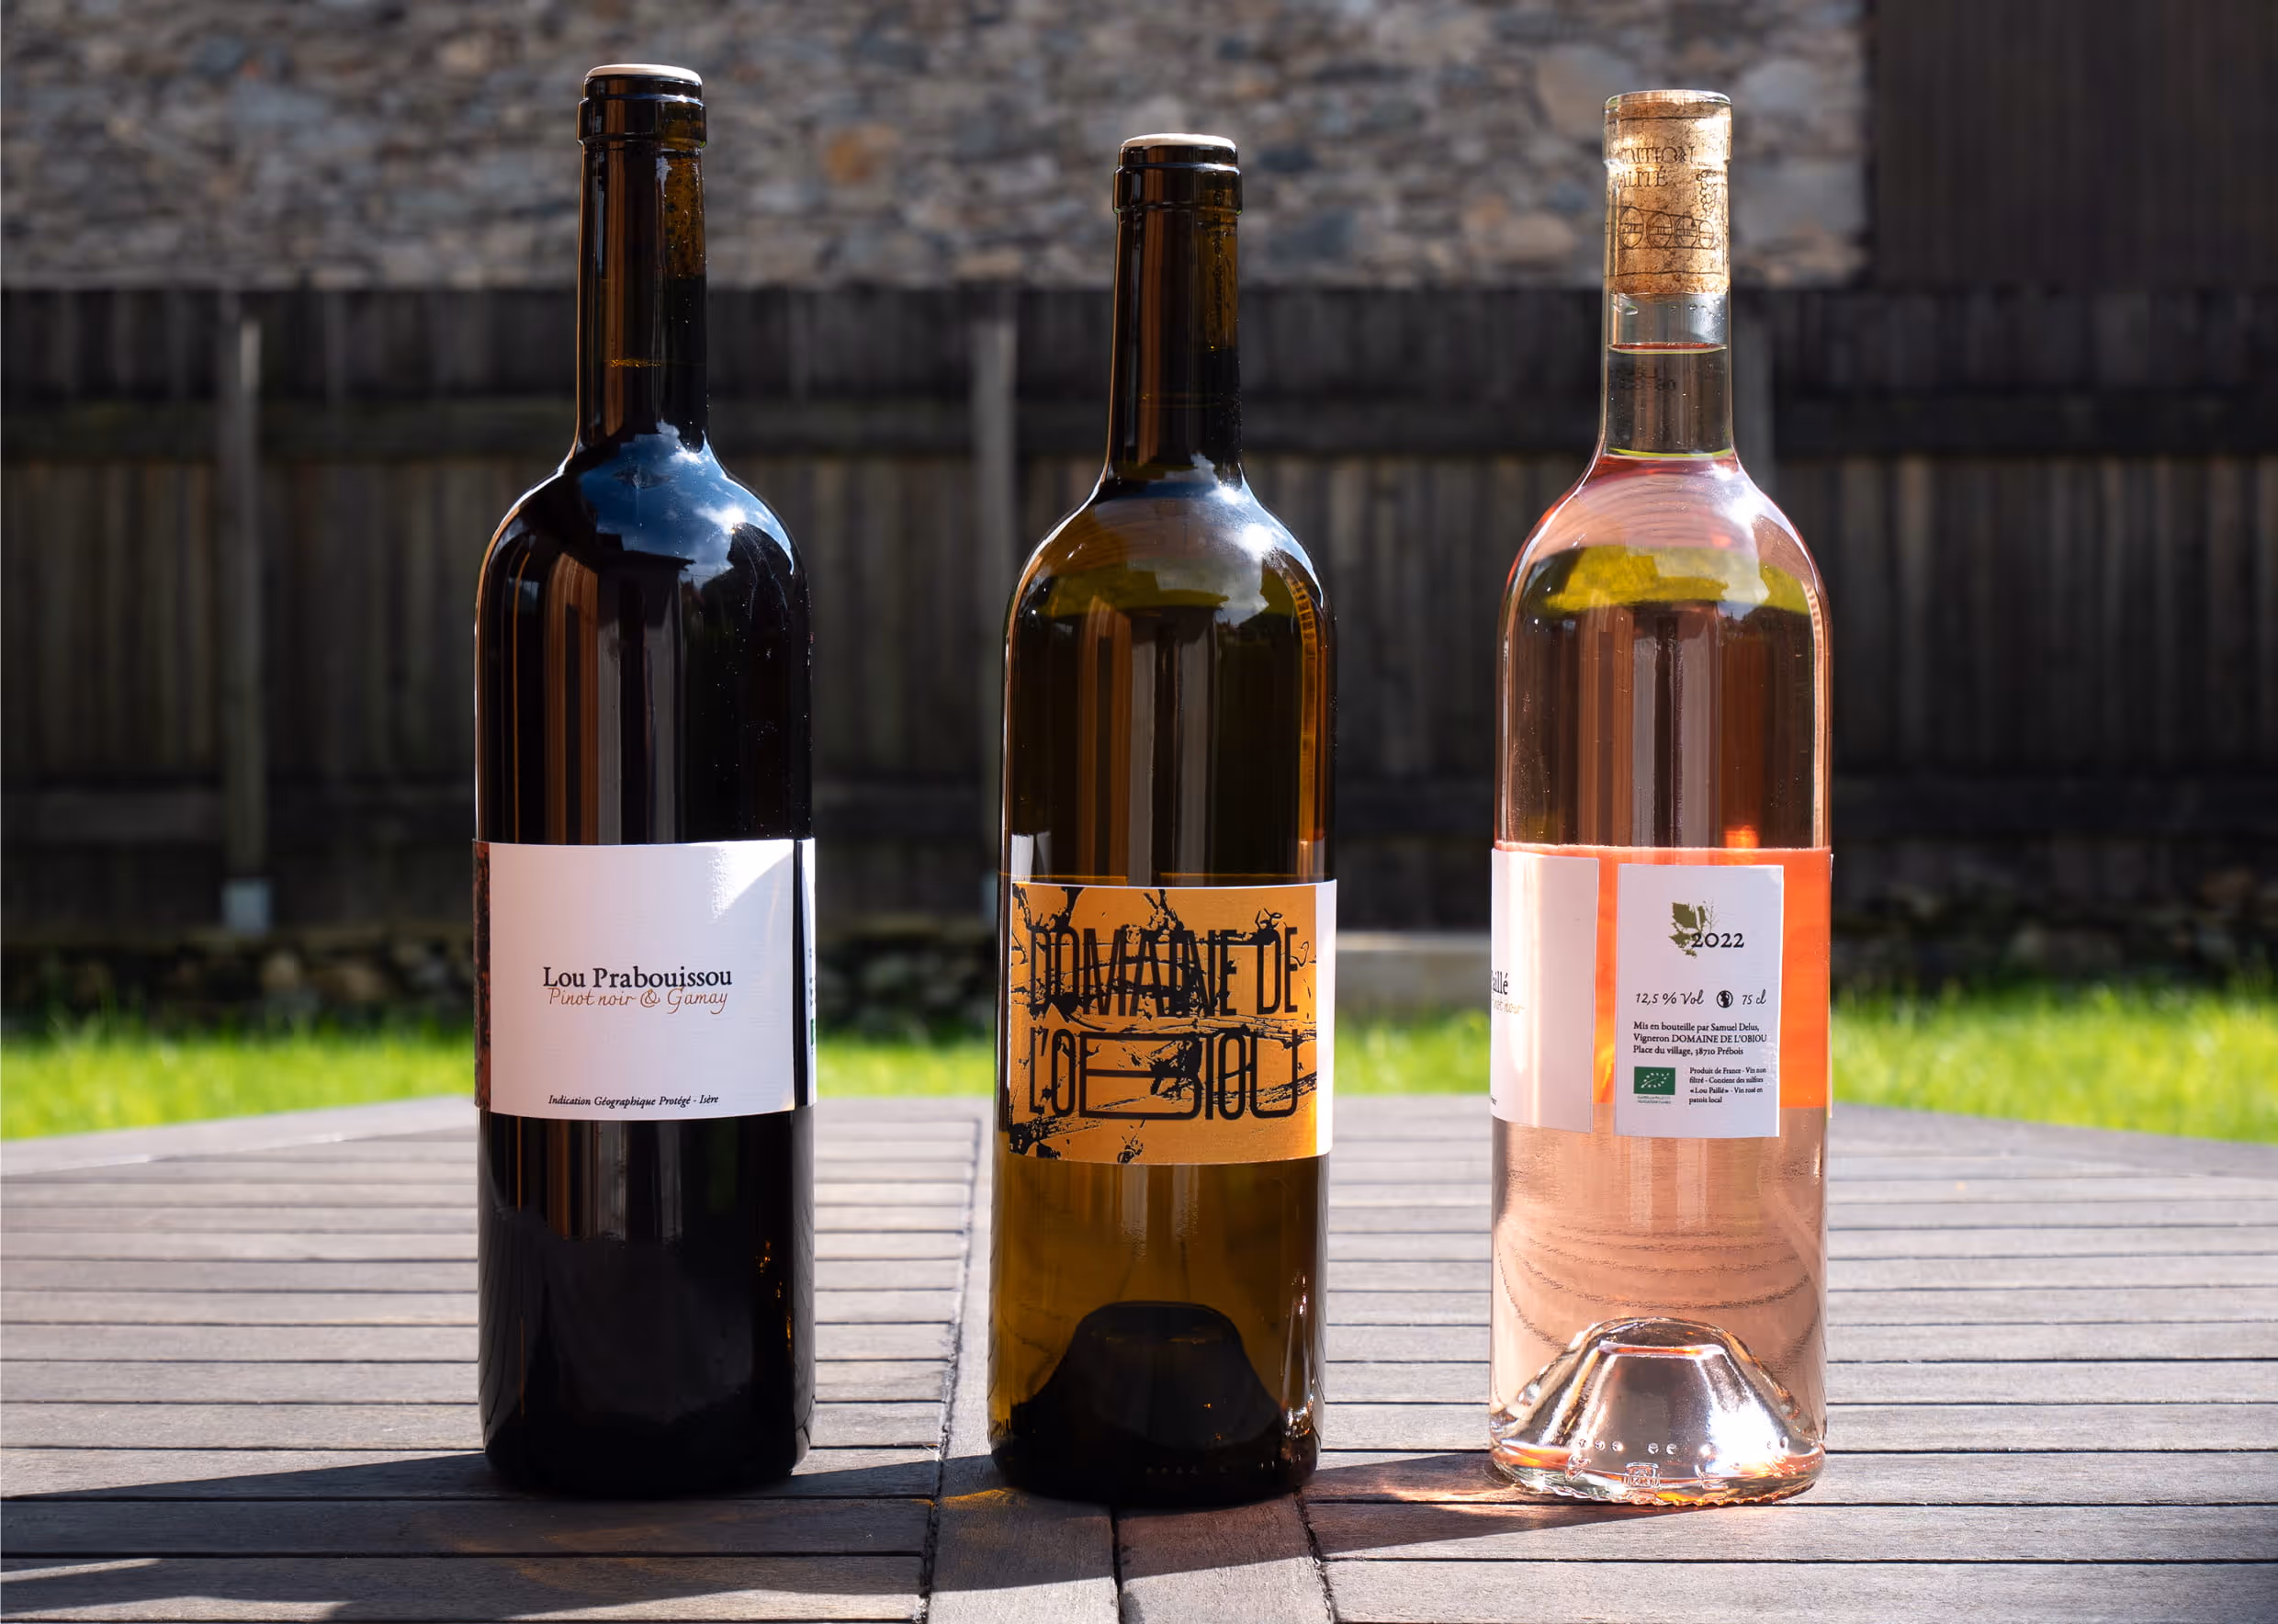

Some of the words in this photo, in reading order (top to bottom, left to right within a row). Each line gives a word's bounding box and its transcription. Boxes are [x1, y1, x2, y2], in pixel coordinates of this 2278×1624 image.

[1690, 932, 1745, 949] 2022
[543, 966, 586, 987] Lou
[592, 965, 733, 988] Prabouissou
[1028, 926, 1237, 1017] DOMAINE
[1257, 926, 1298, 1015] DE
[547, 987, 594, 1006] Pinot
[598, 991, 637, 1006] noir
[640, 988, 660, 1008] &
[667, 987, 727, 1015] Gamay
[1635, 992, 1660, 1007] 12,5
[1662, 992, 1677, 1006] %
[1680, 989, 1705, 1005] Vol
[1742, 994, 1753, 1006] 75
[1755, 988, 1766, 1005] cl
[1633, 1021, 1649, 1031] Mis
[1661, 1021, 1696, 1032] bouteille
[1697, 1024, 1709, 1033] par
[1710, 1022, 1737, 1032] Samuel
[1739, 1022, 1760, 1032] Delus,
[1633, 1033, 1670, 1044] Vigneron
[1672, 1034, 1719, 1043] DOMAINE
[1720, 1034, 1733, 1043] DE
[1734, 1034, 1767, 1043] L'OBIOU
[1633, 1044, 1653, 1054] Place
[1654, 1045, 1665, 1054] du
[1666, 1046, 1694, 1057] village,
[1695, 1047, 1716, 1056] 38710
[1717, 1046, 1744, 1055] Prébois
[1029, 1024, 1299, 1121] L'OBIOU
[1689, 1066, 1713, 1075] Produit
[1714, 1066, 1722, 1075] de
[547, 1095, 591, 1105] Indication
[593, 1096, 657, 1109] Géographique
[659, 1096, 691, 1109] Protégé
[699, 1094, 719, 1104] Isère
[1688, 1096, 1708, 1105] patois
